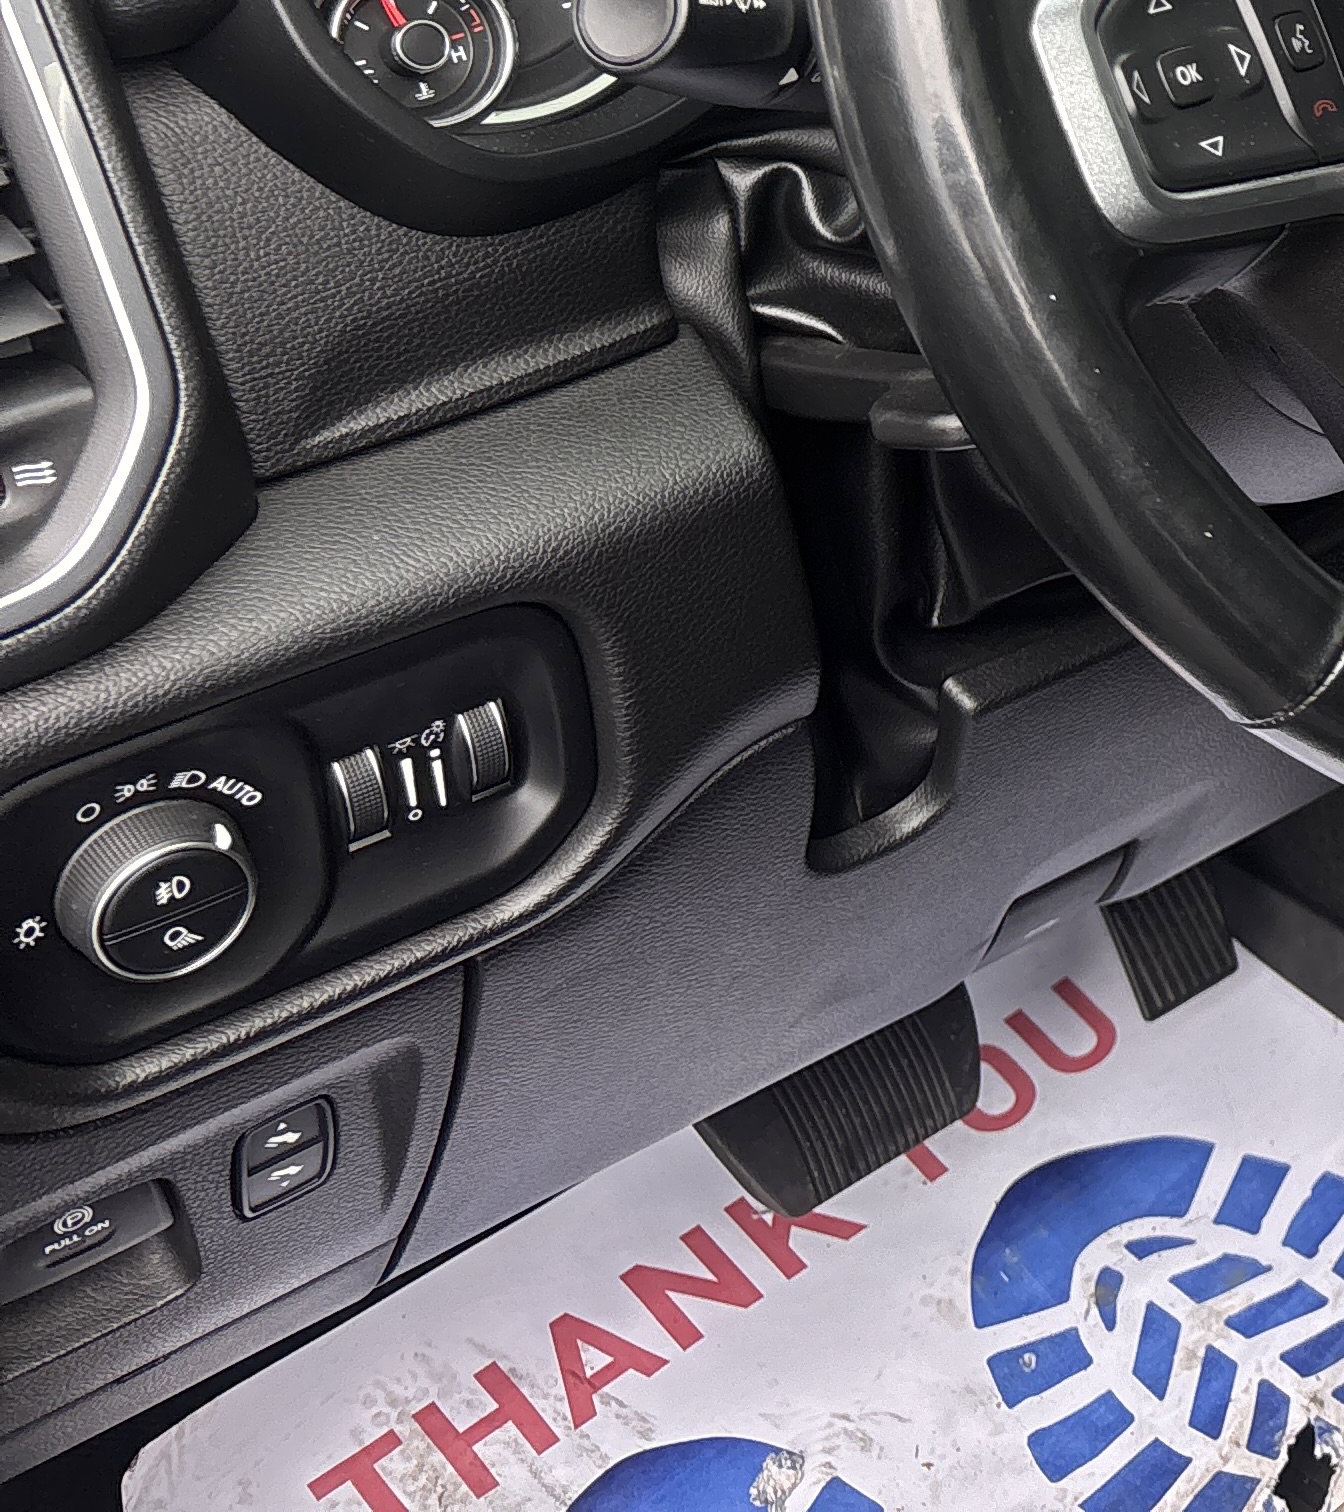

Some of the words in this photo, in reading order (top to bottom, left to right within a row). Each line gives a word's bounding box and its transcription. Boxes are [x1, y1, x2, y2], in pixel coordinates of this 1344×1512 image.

[450, 45, 467, 64] H
[1175, 63, 1203, 86] OK
[208, 775, 263, 807] AUTO
[904, 975, 1119, 1183] OU
[44, 1232, 82, 1255] PULL
[84, 1219, 111, 1237] ON
